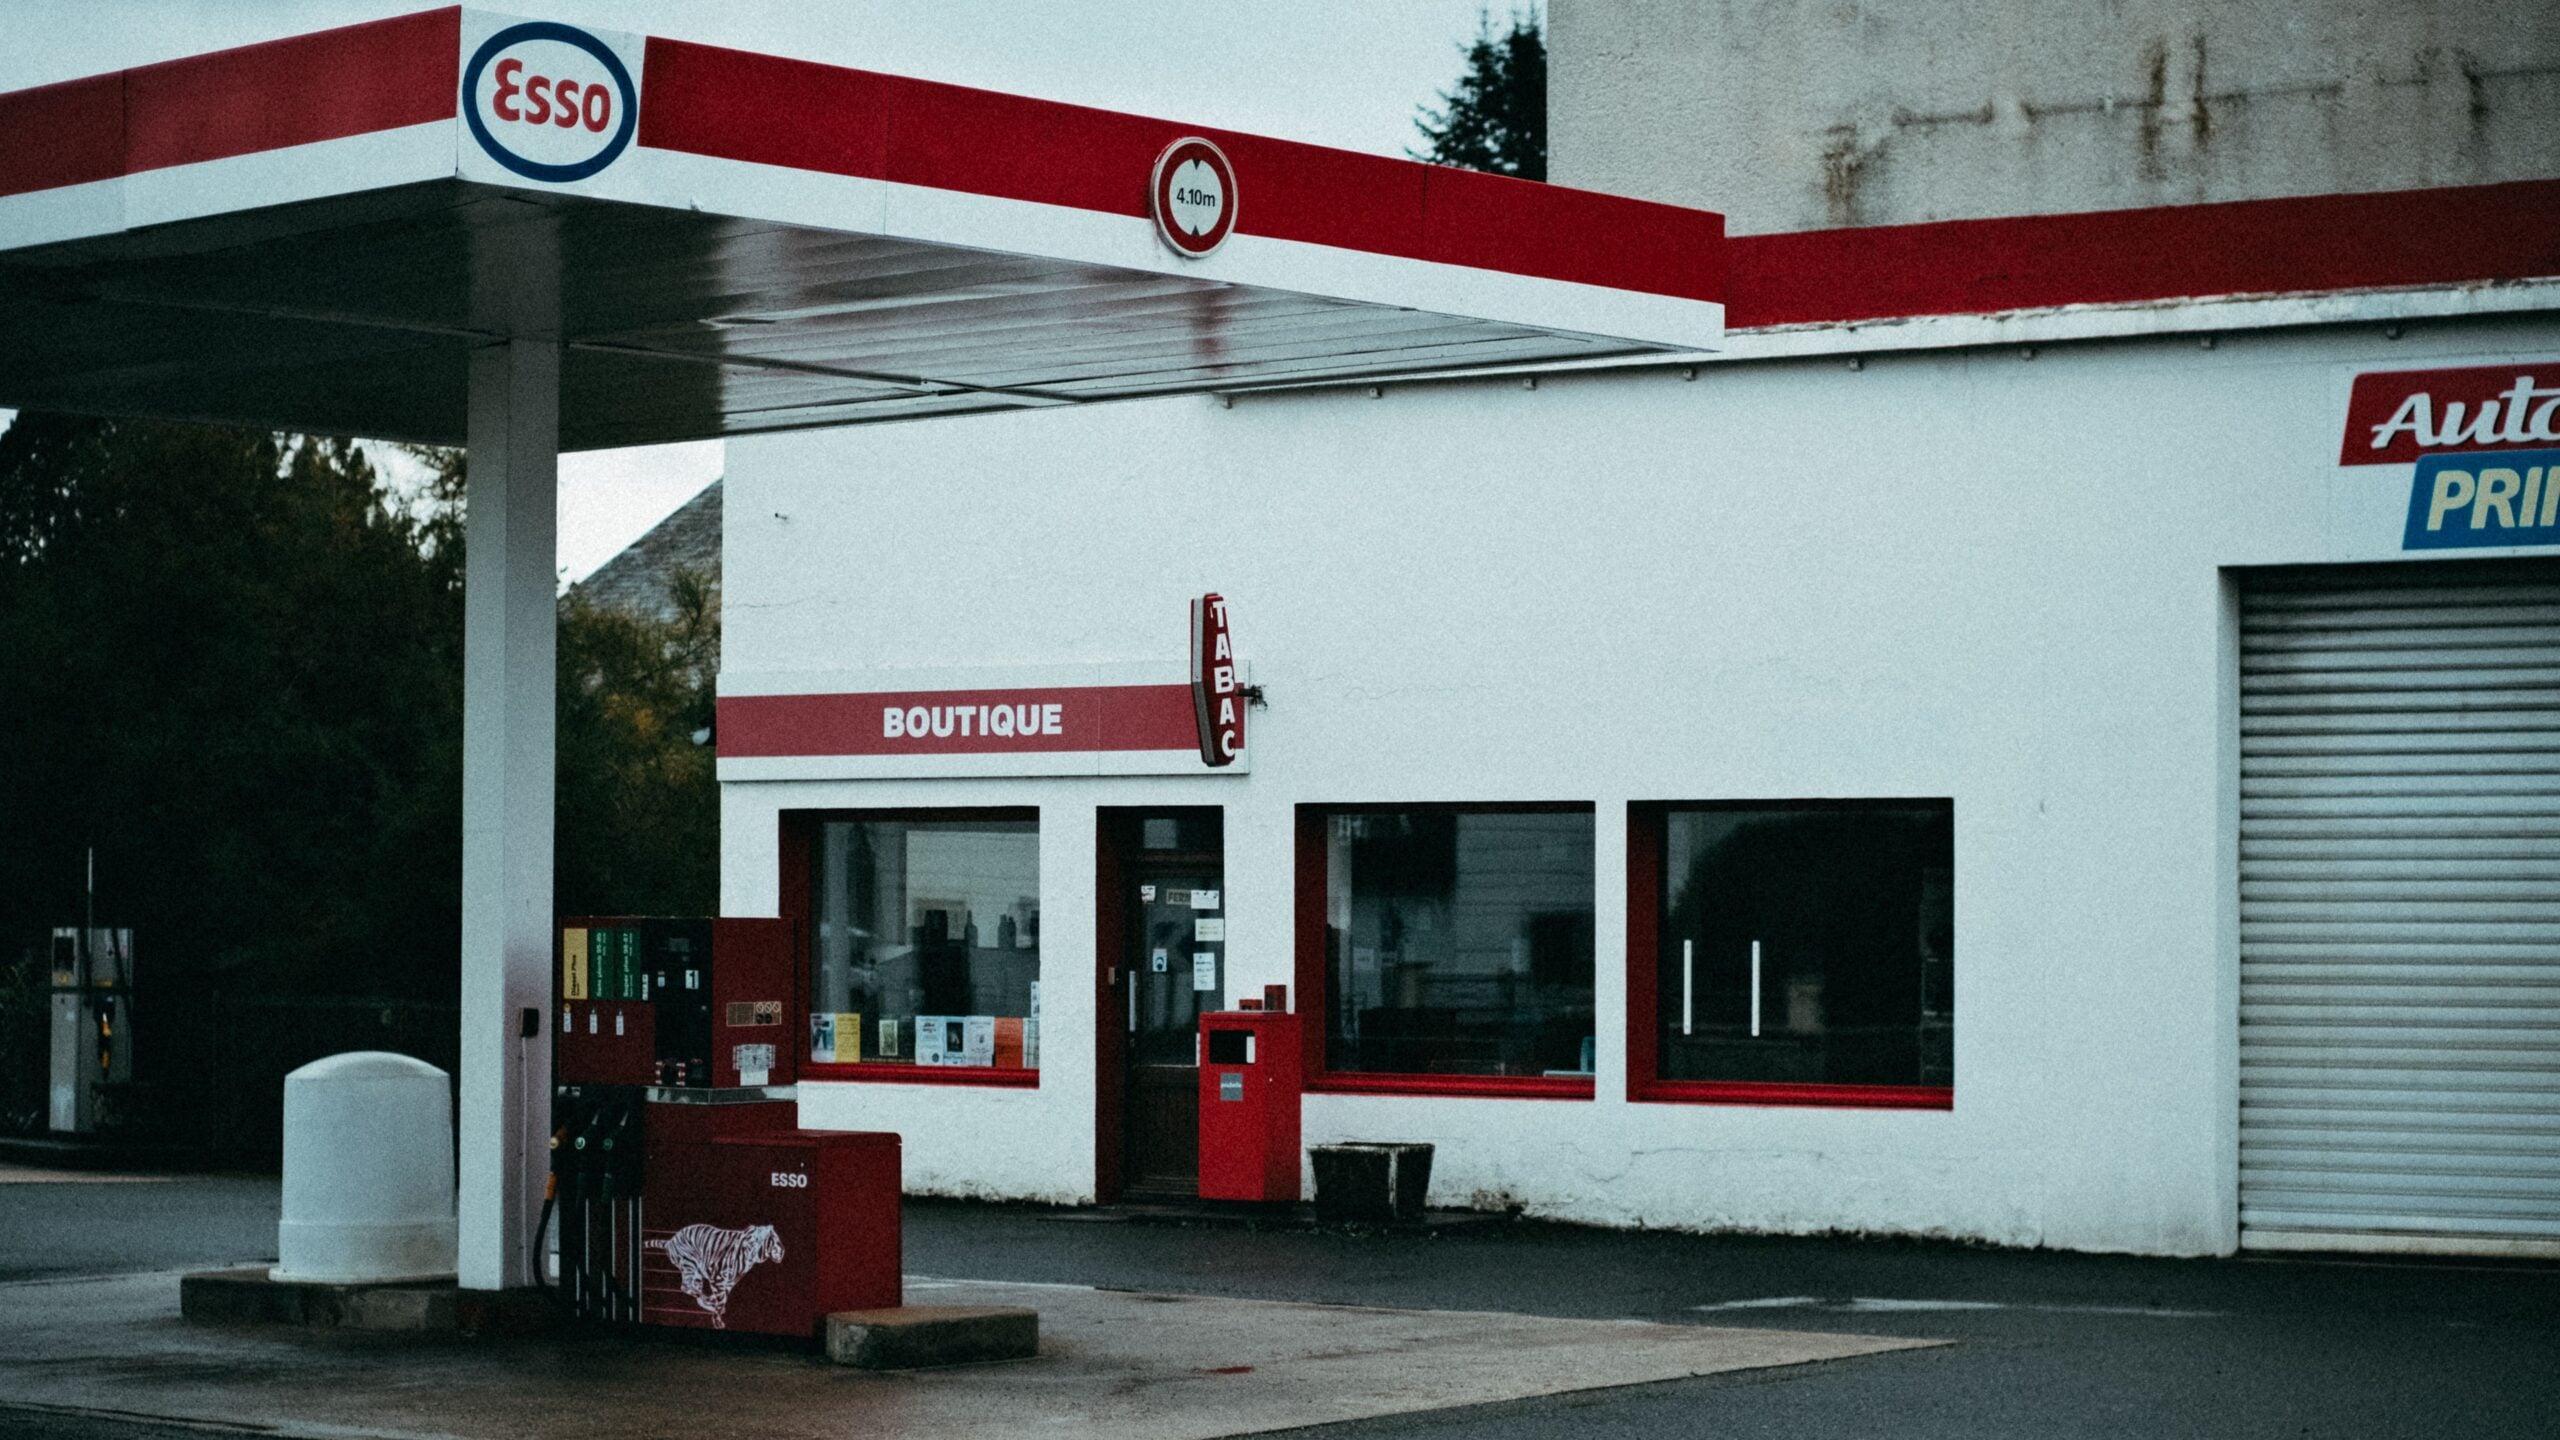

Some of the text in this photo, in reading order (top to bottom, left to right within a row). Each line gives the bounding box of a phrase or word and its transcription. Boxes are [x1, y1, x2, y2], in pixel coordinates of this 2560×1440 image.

[1176, 187, 1216, 207] 4.10m
[1212, 600, 1236, 758] TABAC
[883, 703, 1063, 739] BOUTIQUE
[771, 1172, 808, 1188] ESSO
